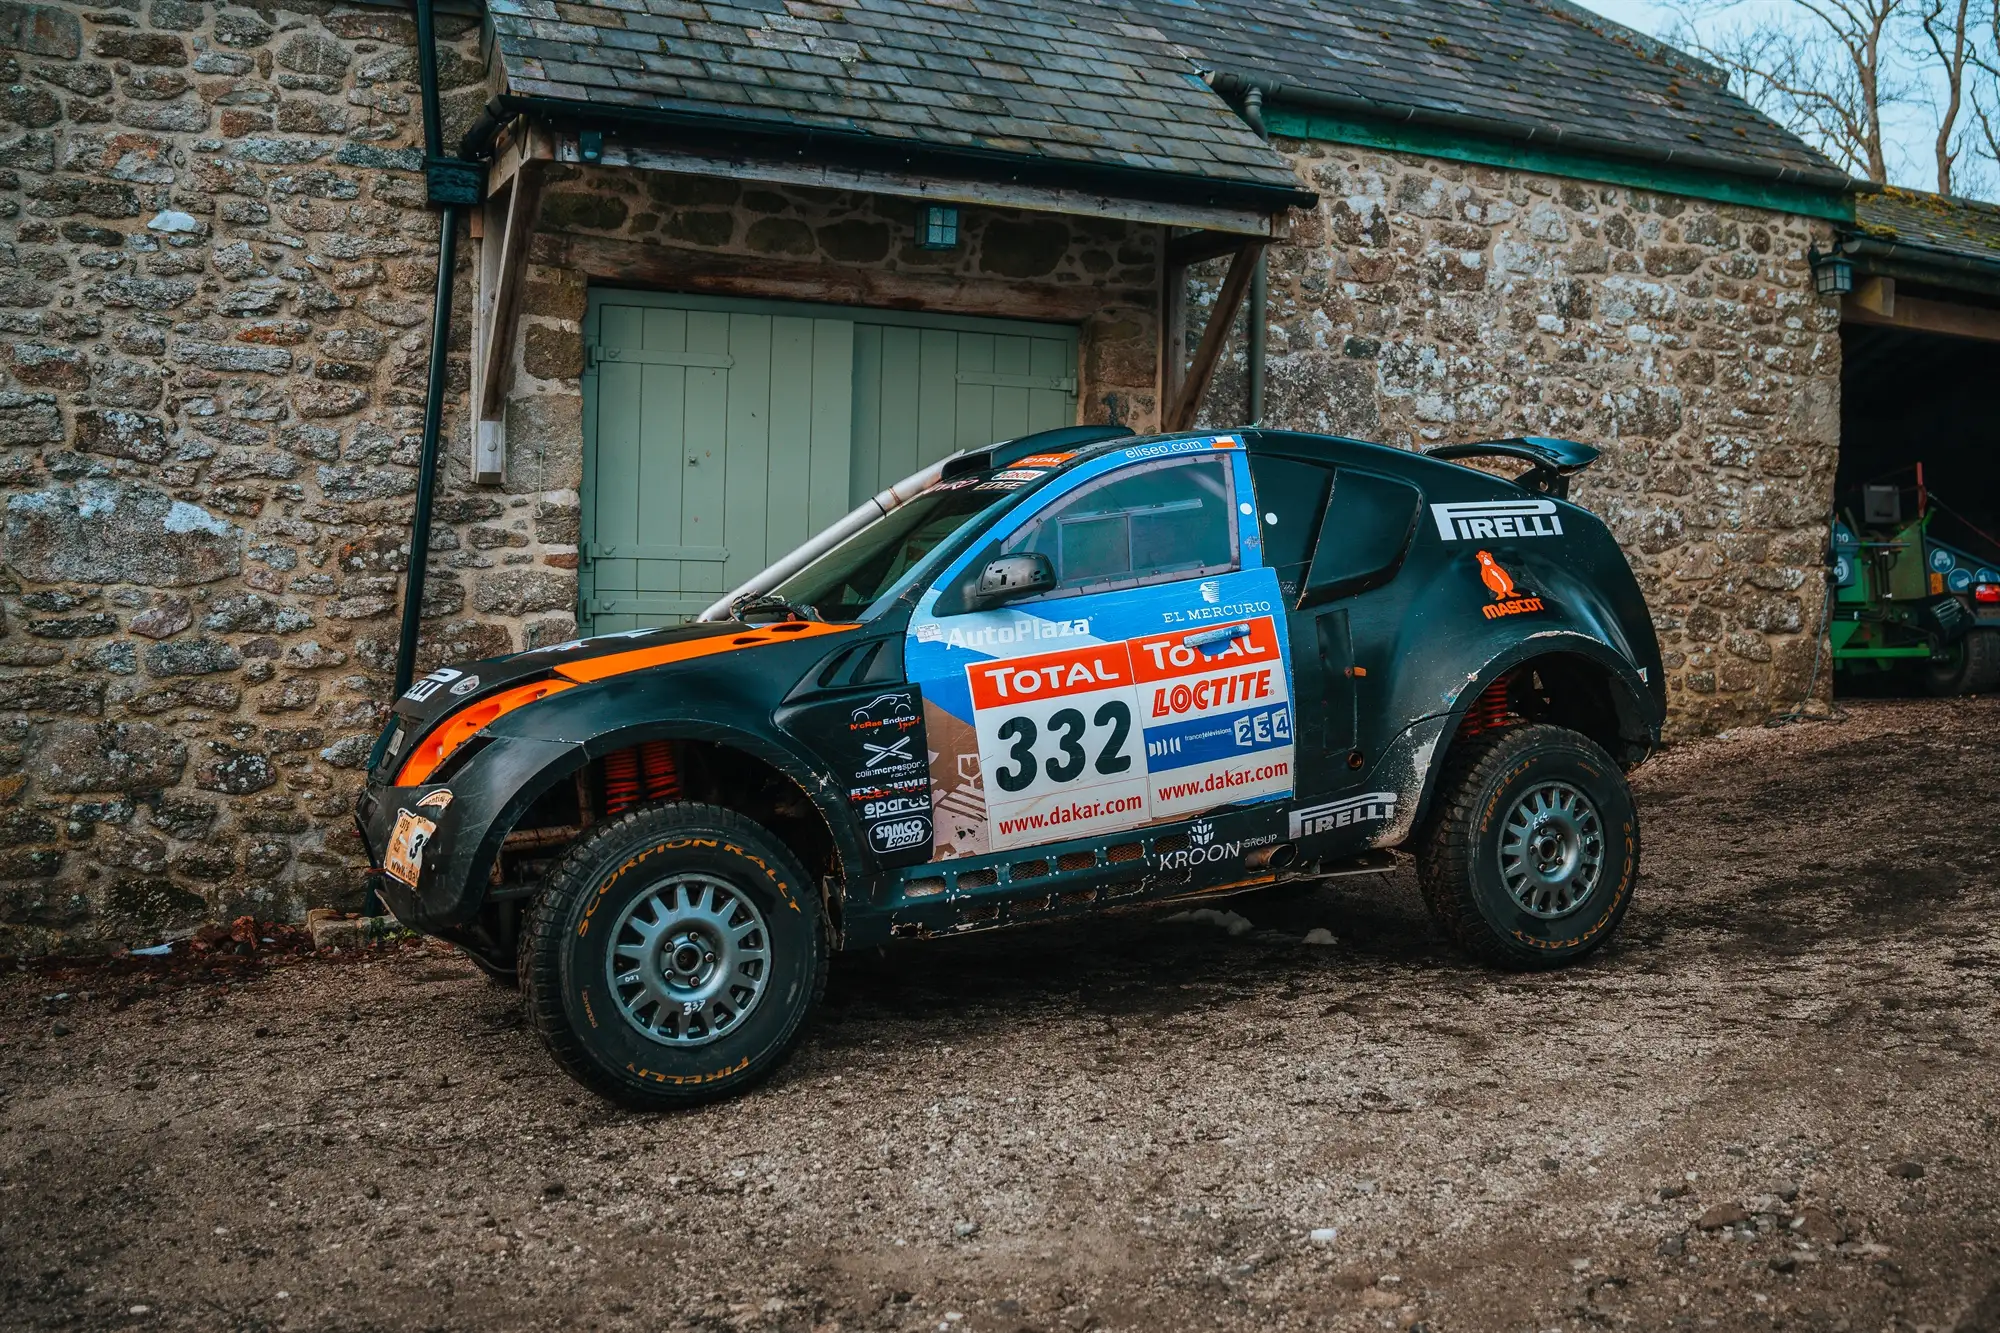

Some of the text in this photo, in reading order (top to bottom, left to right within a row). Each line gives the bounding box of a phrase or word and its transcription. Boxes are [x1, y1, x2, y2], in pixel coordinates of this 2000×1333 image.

[1125, 440, 1203, 459] eliseo.com
[1430, 500, 1564, 541] PIRELLI
[1162, 601, 1271, 623] EL MERCURIO
[1482, 597, 1545, 620] MASCOT
[946, 618, 1091, 650] AutoPlaza
[984, 659, 1120, 698] TOTAL
[1152, 669, 1271, 718] LOCTITE
[995, 700, 1132, 793] 332
[1158, 761, 1289, 801] www.dakar.com
[875, 819, 923, 840] SAMCO
[998, 795, 1143, 835] www.dakar.com
[1289, 791, 1398, 840] PIRELLI
[1159, 841, 1241, 872] KROON
[1243, 834, 1278, 849] GROUP
[577, 838, 801, 938] SCORPION RALLY
[1511, 822, 1633, 949] SCORPION RALLY
[638, 1056, 751, 1085] PIRELLI
